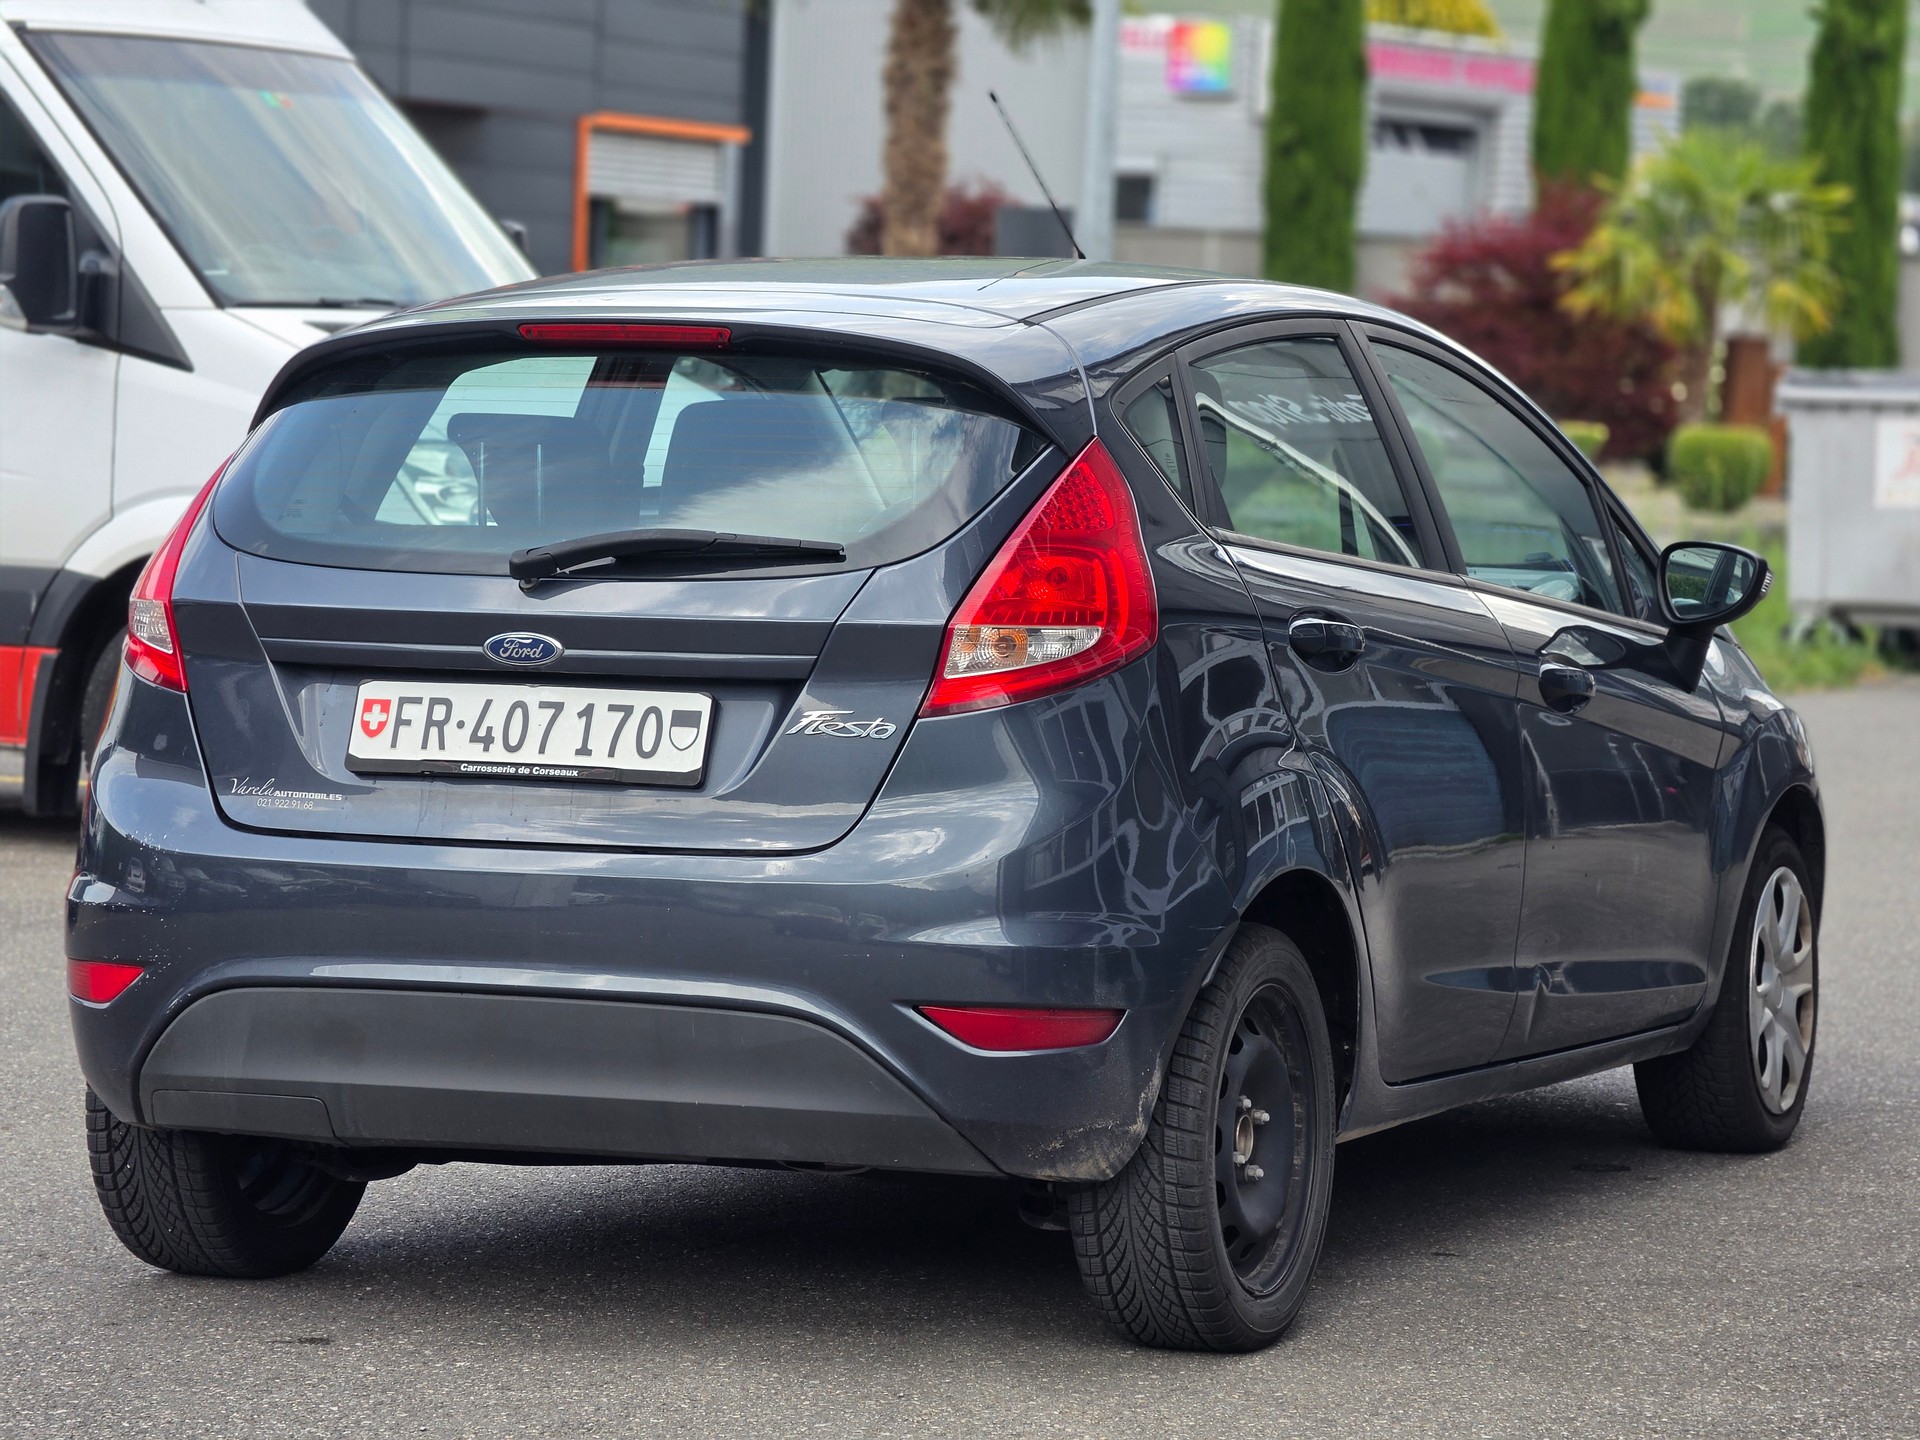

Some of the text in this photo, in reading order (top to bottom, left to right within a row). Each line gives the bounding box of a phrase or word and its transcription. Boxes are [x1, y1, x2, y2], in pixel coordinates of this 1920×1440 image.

[499, 638, 544, 658] Ford
[785, 710, 897, 739] Fiesta
[460, 763, 579, 777] Carrosserie de Corseaux
[230, 777, 276, 797] Varela
